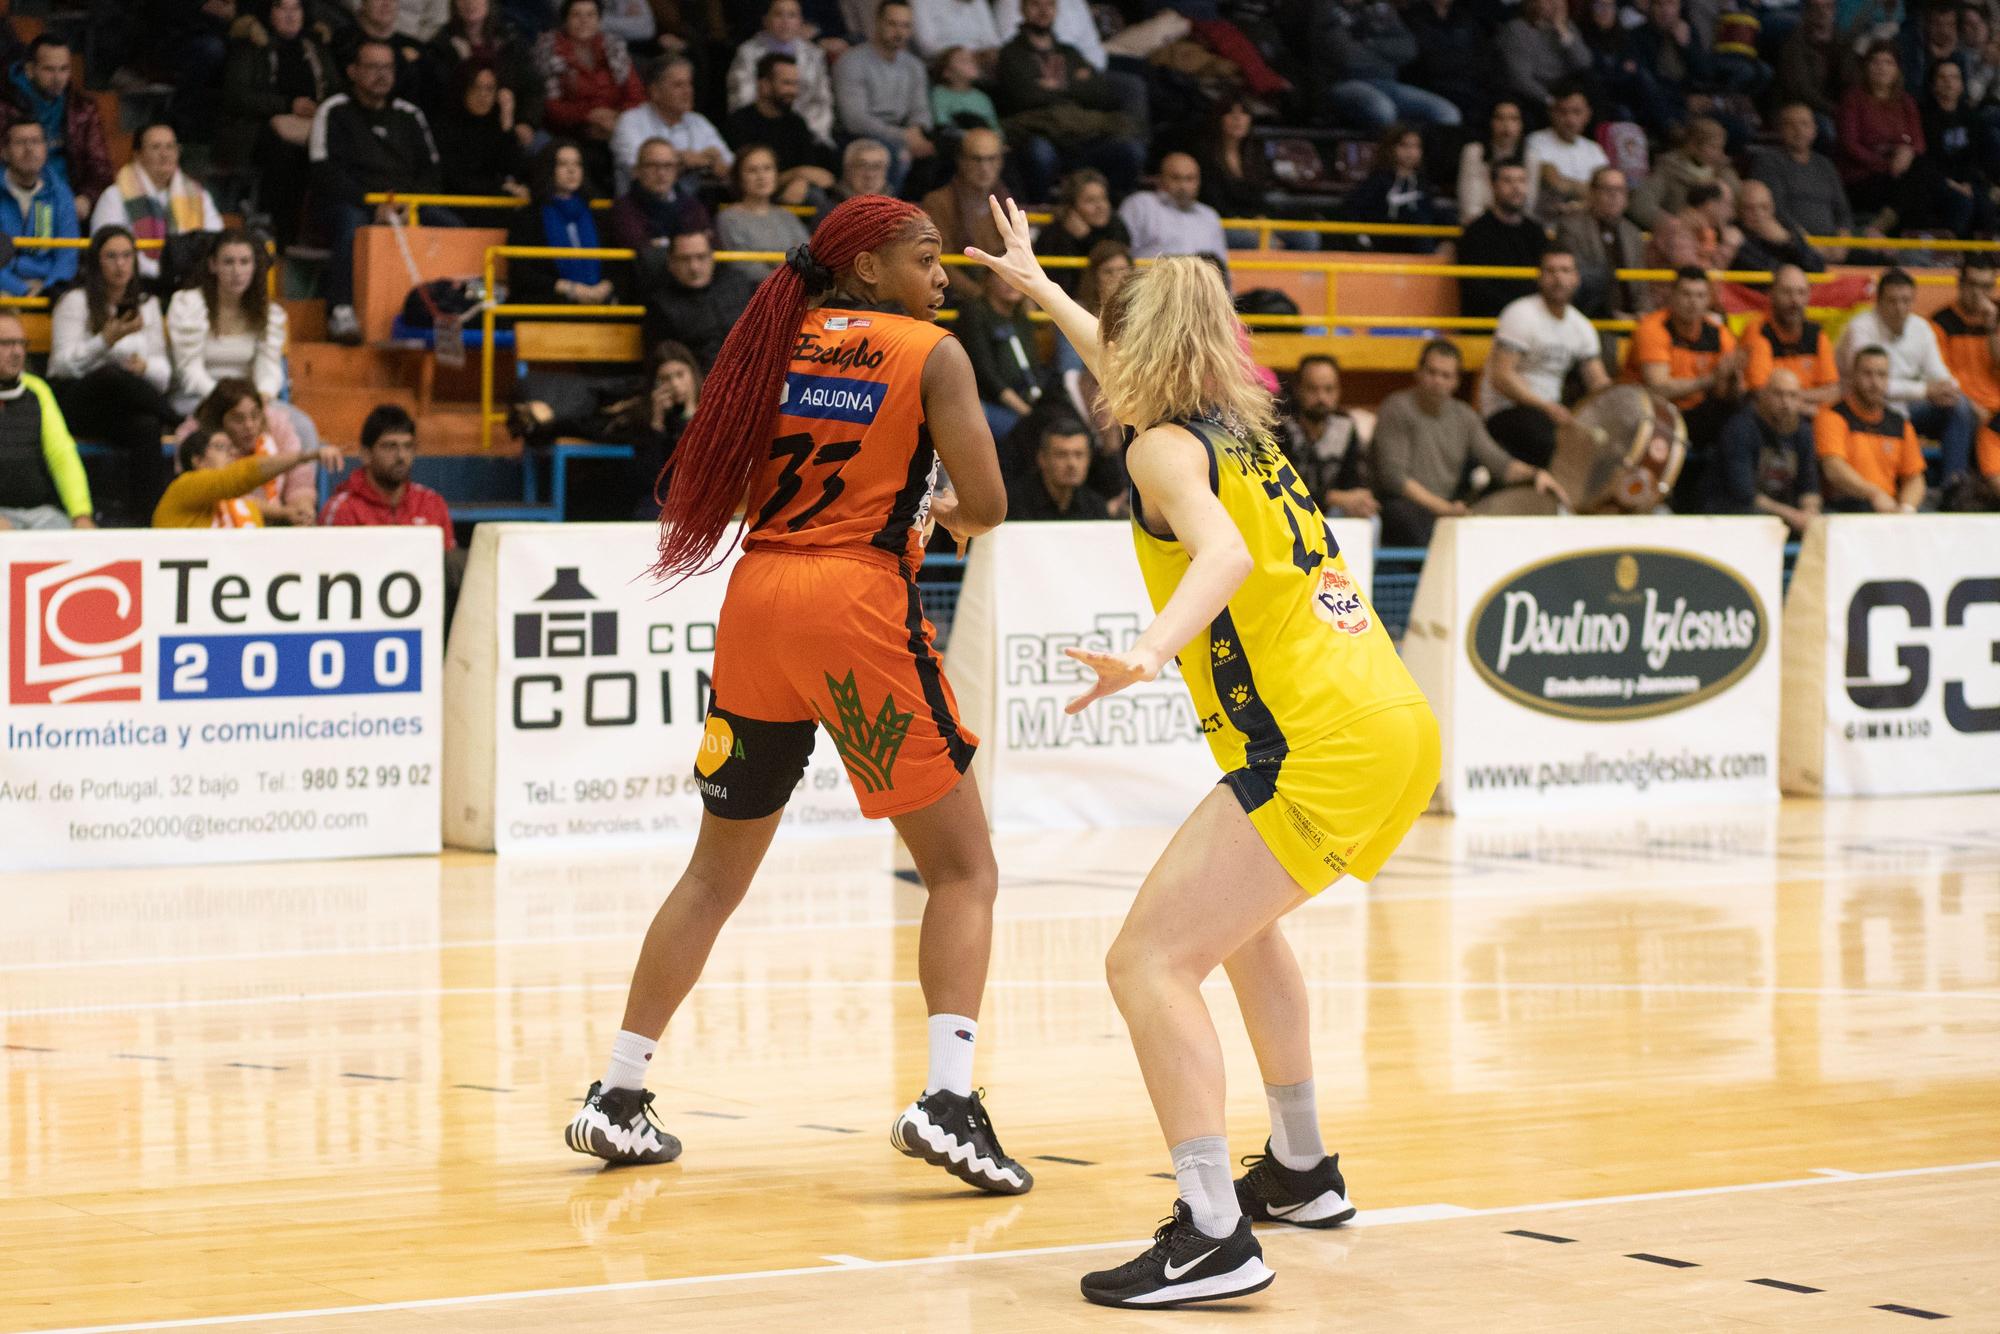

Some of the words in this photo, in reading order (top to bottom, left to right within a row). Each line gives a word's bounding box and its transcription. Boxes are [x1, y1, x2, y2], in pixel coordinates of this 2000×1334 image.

[800, 387, 873, 413] AQUONA
[159, 559, 422, 624] Tecno
[1497, 591, 1630, 673] Paulino
[1641, 588, 1756, 670] Iglesias
[173, 637, 410, 693] 2000
[8, 722, 167, 750] Informática
[178, 727, 191, 749] y
[201, 713, 423, 743] comunicaciones
[1007, 692, 1202, 750] MARTA
[1845, 720, 1931, 740] GIMNASIO
[0, 780, 42, 802] Avd.
[49, 781, 74, 801] de
[81, 777, 163, 802] Portugal,
[170, 774, 193, 797] 32
[200, 774, 239, 799] bajo
[302, 768, 339, 790] 980
[346, 766, 369, 788] 52
[376, 765, 401, 786] 99
[408, 763, 432, 785] 02
[574, 778, 617, 801] 980
[623, 777, 648, 799] 57
[655, 774, 676, 796] 13
[1466, 750, 1768, 793] www.paulinoiglesias.com
[69, 810, 369, 841] tecno2000@tecno2000.com
